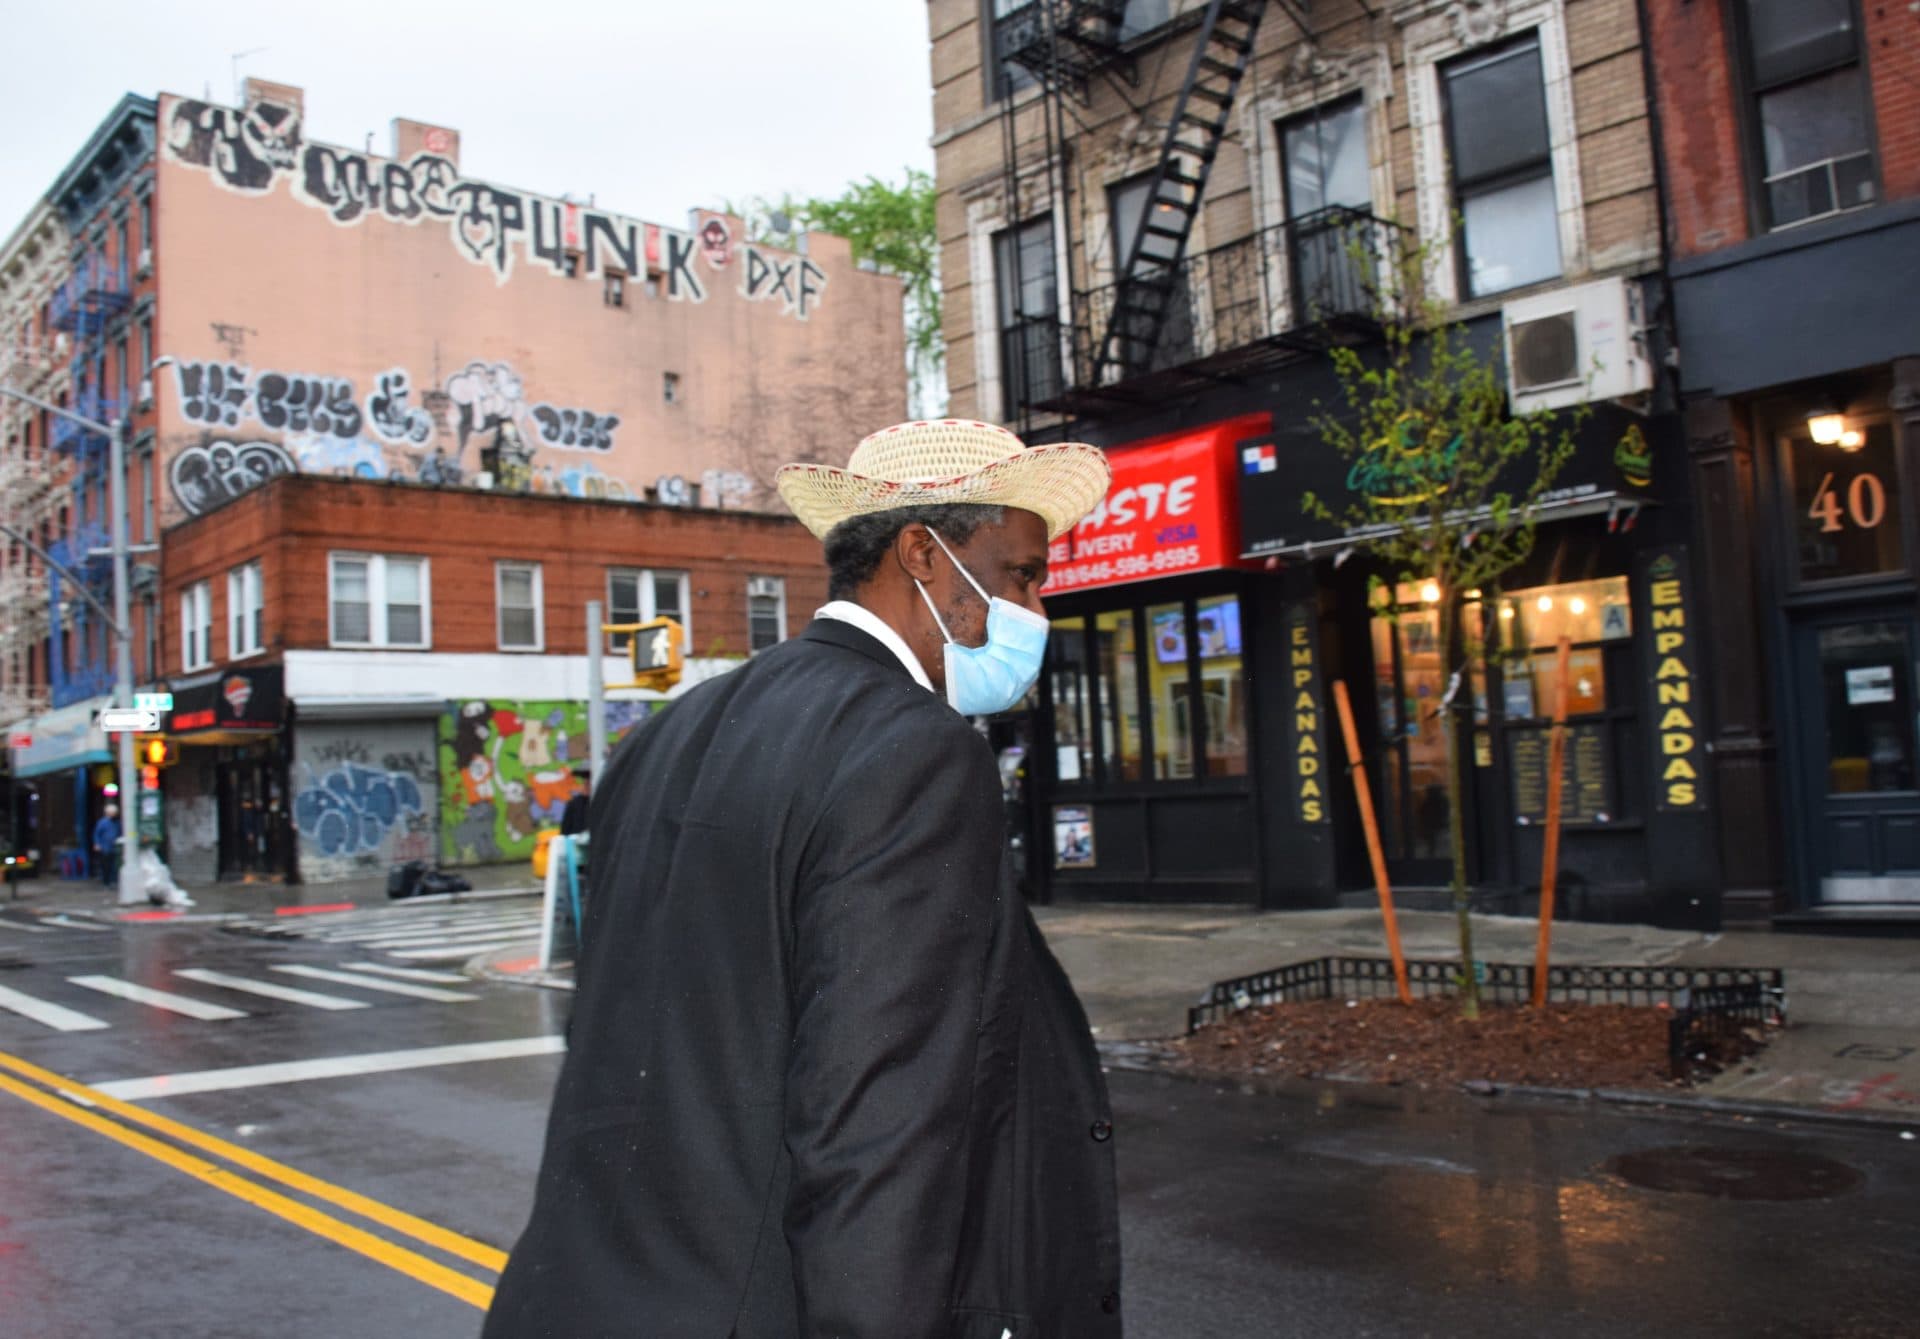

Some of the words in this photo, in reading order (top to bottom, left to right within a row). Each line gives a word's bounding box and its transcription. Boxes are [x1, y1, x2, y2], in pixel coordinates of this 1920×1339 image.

[1807, 472, 1887, 533] 40
[1291, 626, 1323, 823] EMPANADAS
[1649, 580, 1697, 807] EMPANADAS
